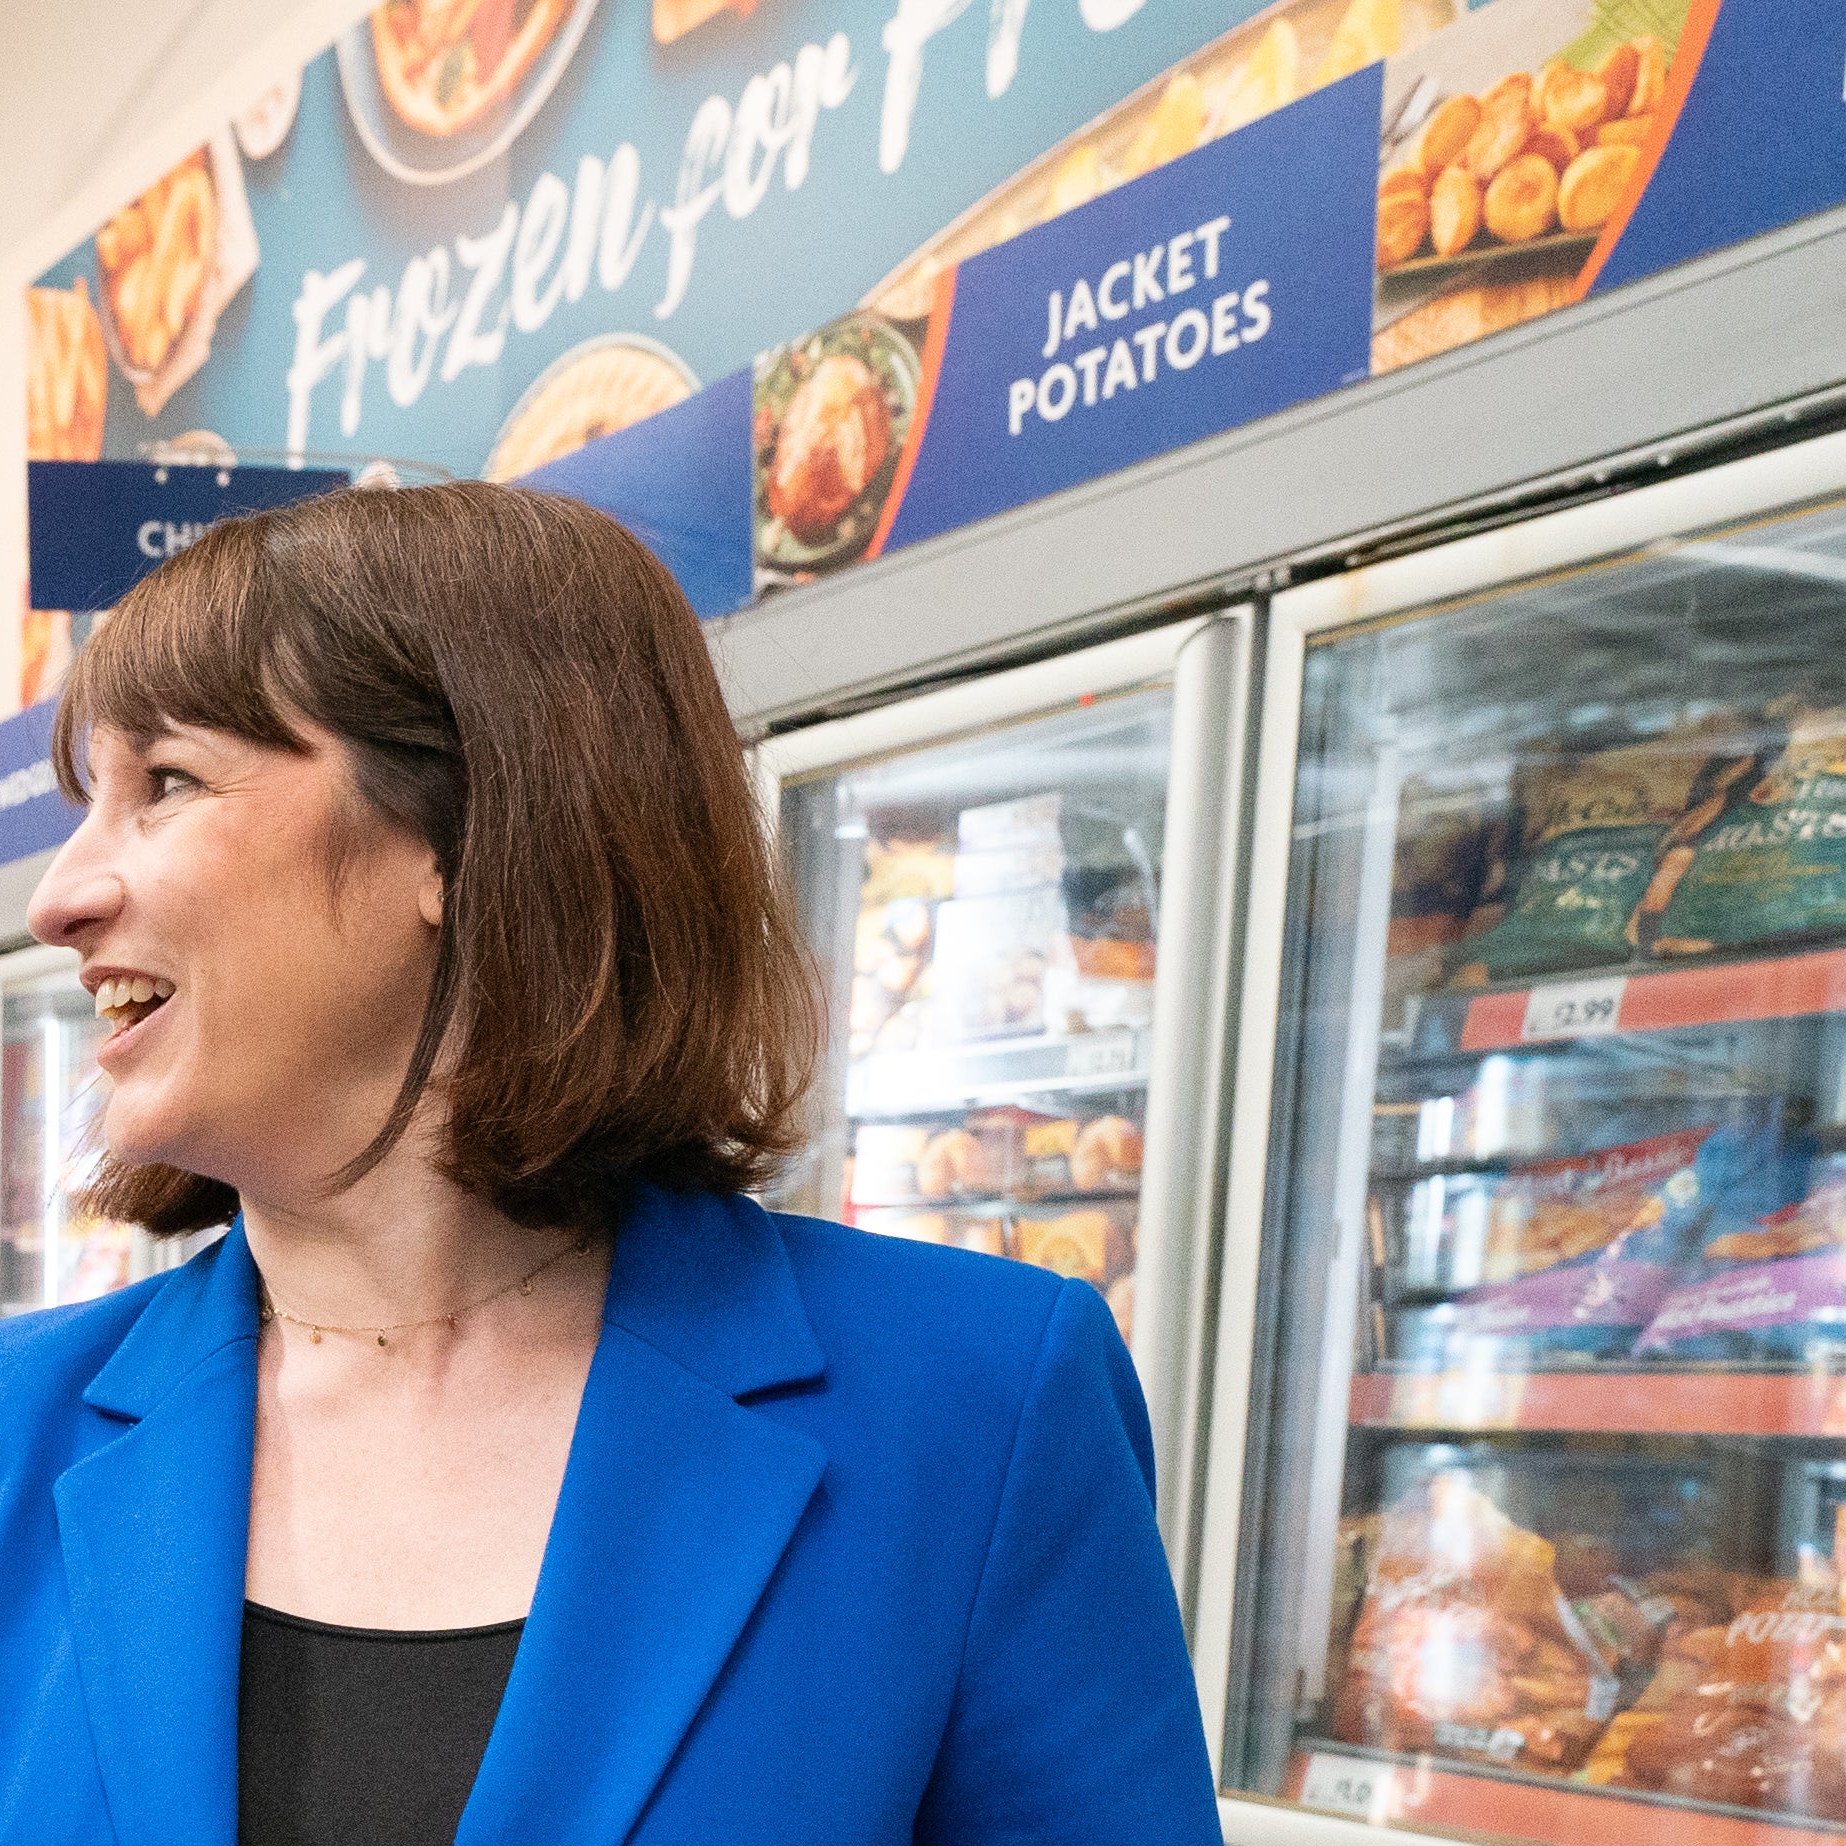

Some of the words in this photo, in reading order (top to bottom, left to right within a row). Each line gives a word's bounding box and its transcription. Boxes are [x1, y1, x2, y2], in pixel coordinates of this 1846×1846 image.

[286, 200, 656, 472] Frozen
[653, 32, 857, 320] for
[1042, 214, 1232, 359] JACKET
[1008, 279, 1272, 437] POTATOES
